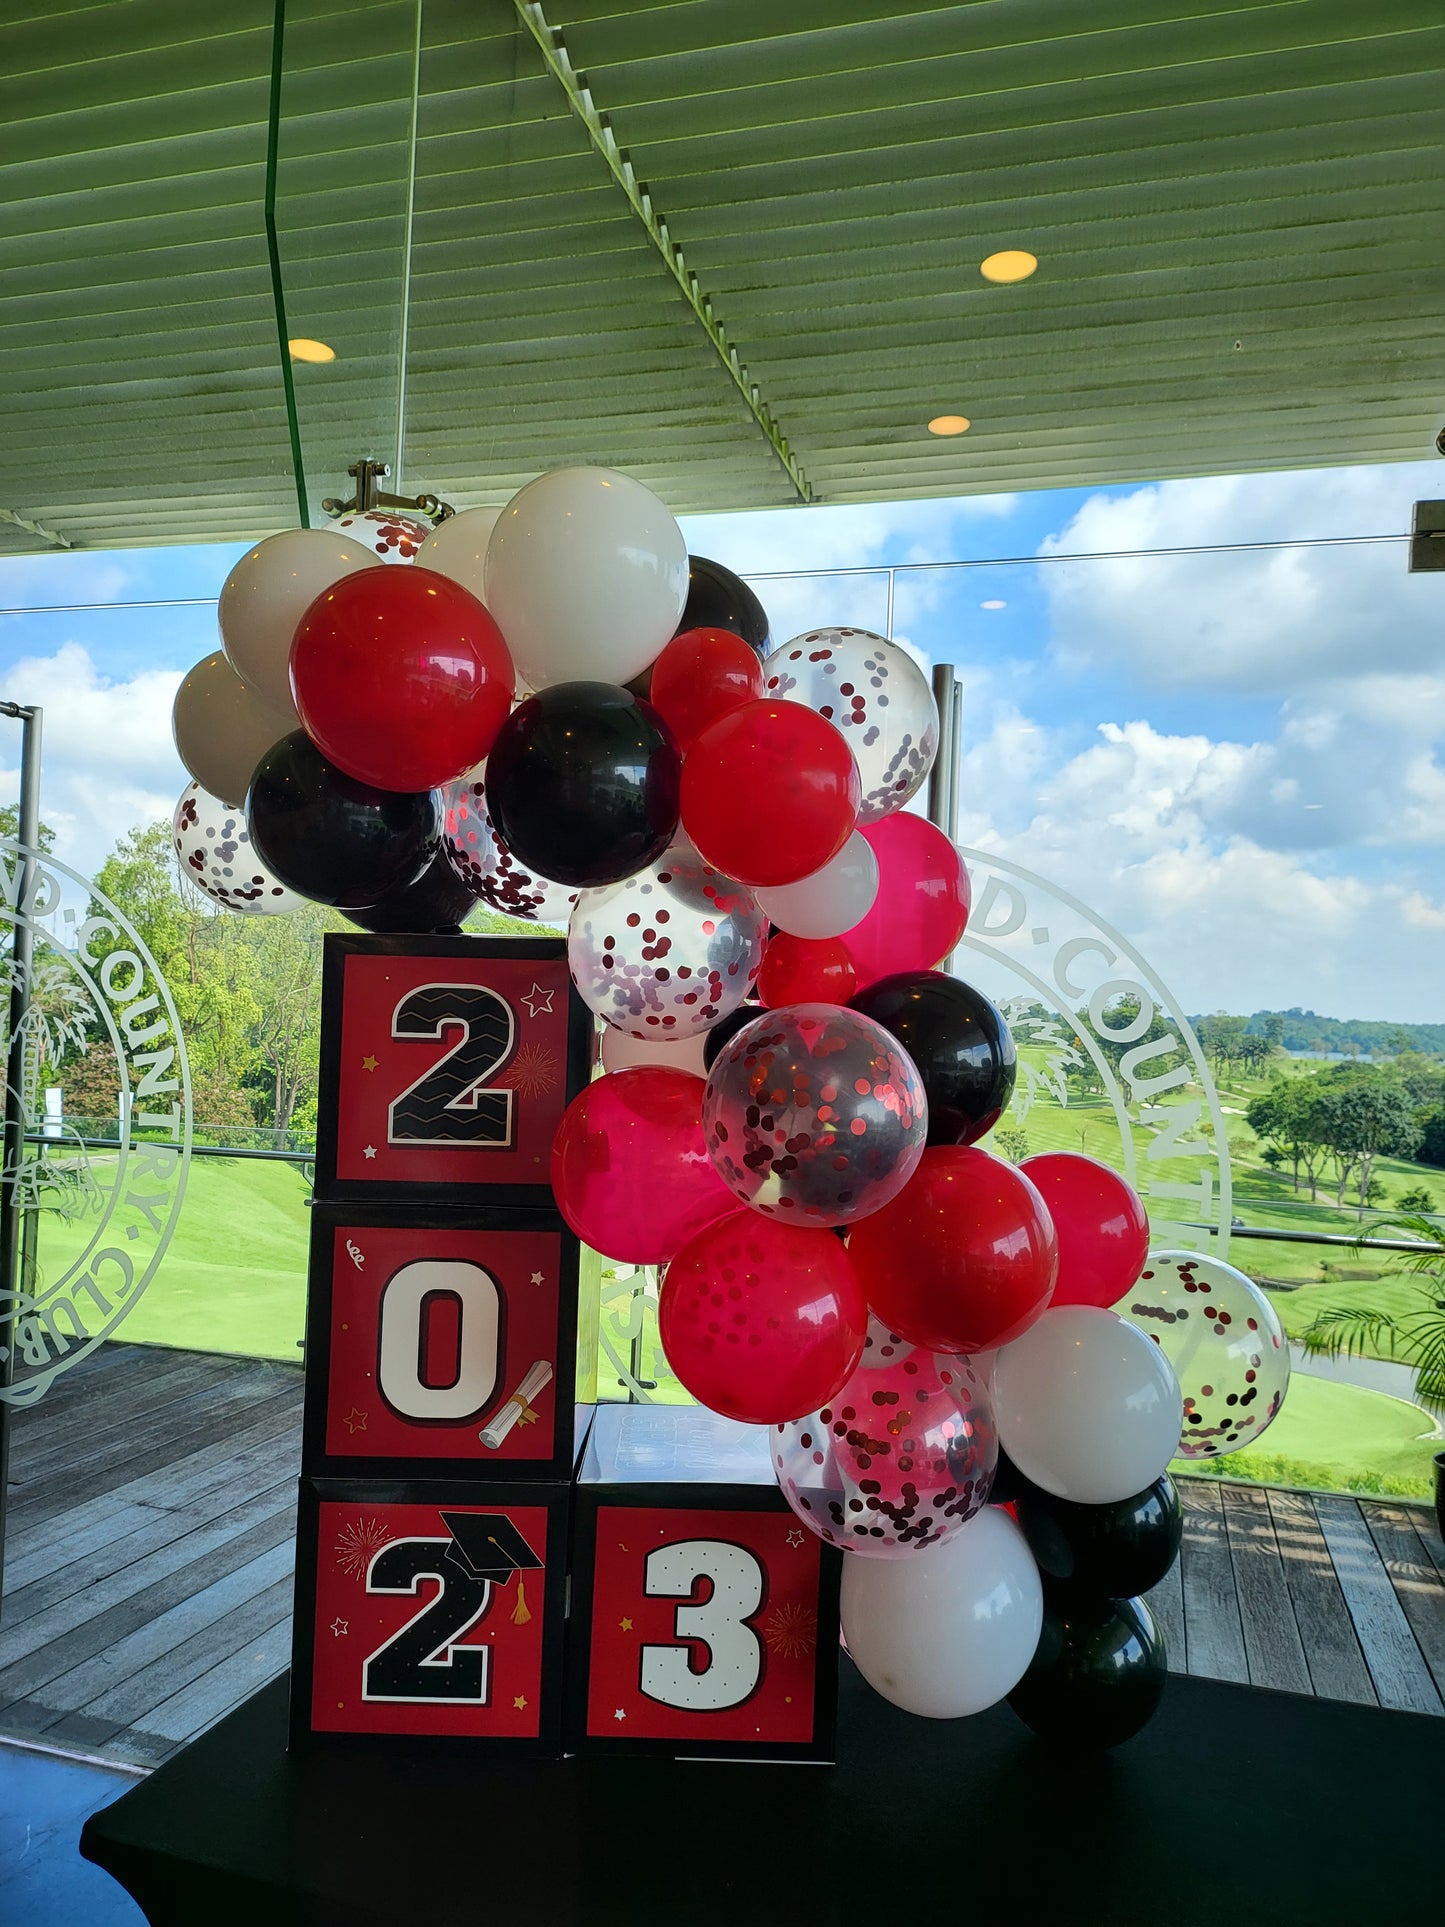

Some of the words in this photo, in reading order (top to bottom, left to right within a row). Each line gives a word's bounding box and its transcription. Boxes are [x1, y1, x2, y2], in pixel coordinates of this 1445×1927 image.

[78, 916, 181, 1233] COUNTRY
[388, 982, 515, 1147] 2
[15, 1247, 134, 1366] CLUB
[377, 1257, 502, 1421] 0
[362, 1536, 489, 1704] 2
[639, 1537, 764, 1713] 3
